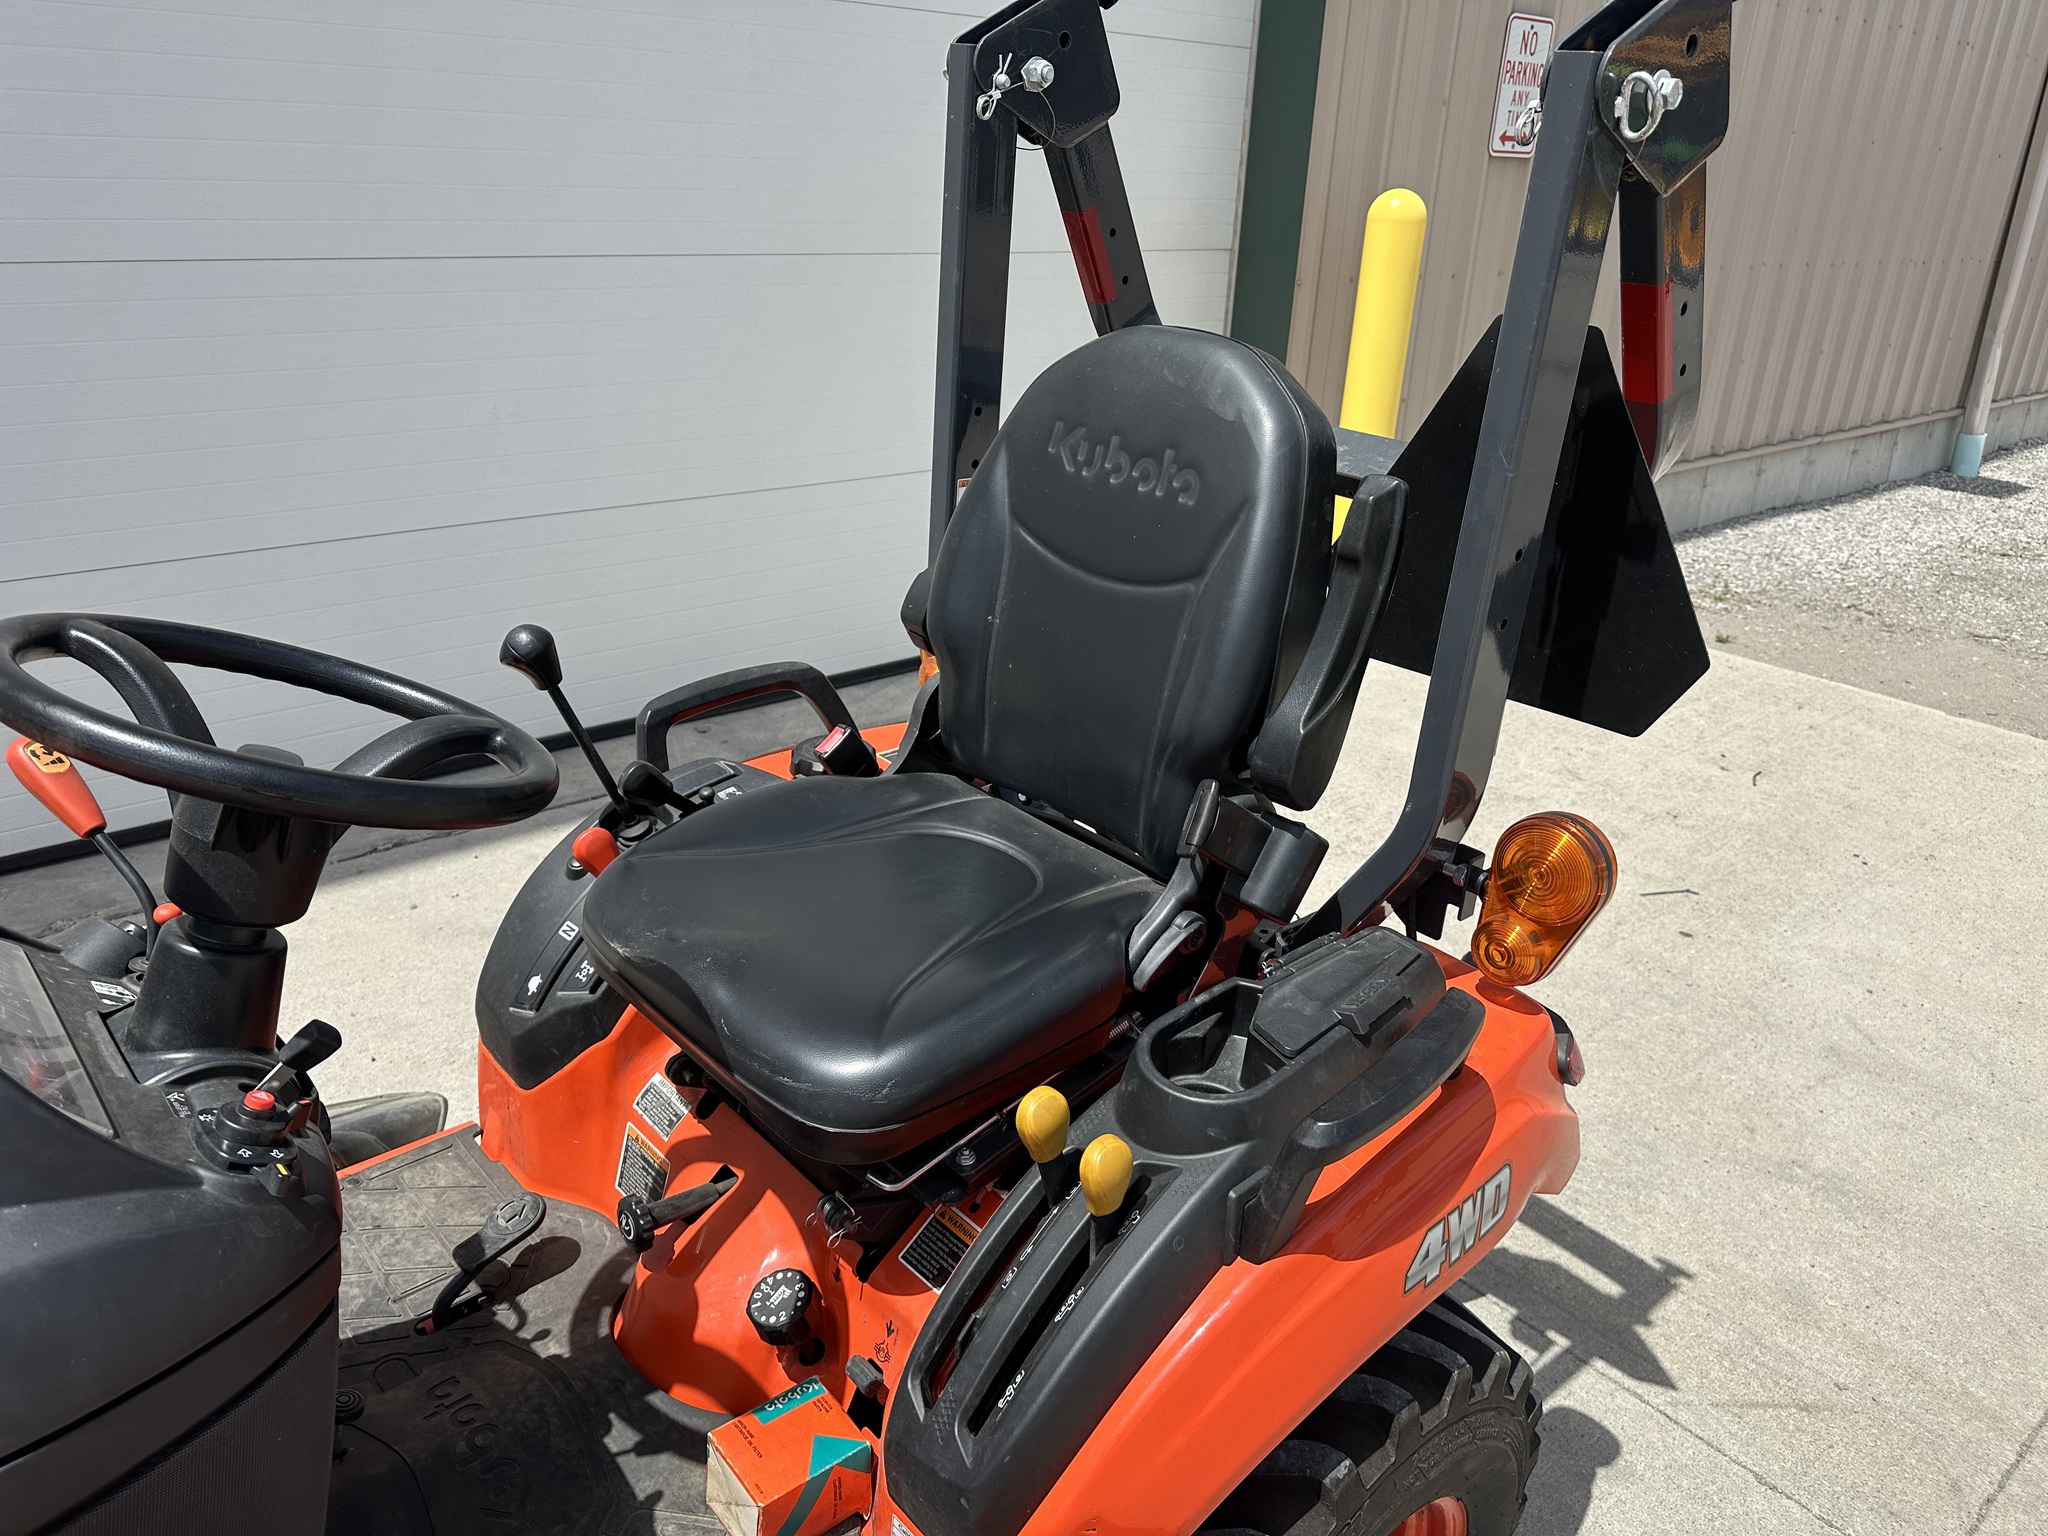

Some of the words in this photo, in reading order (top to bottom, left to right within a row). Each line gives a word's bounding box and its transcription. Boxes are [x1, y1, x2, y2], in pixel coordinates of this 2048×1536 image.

[1519, 29, 1539, 57] NO
[1510, 90, 1530, 107] ANY
[1047, 420, 1200, 506] Kubota
[560, 923, 577, 939] N
[657, 1079, 688, 1109] IMPORTANT
[639, 1139, 663, 1165] WARNING
[1403, 1163, 1512, 1294] 4WD
[766, 1276, 774, 1286] 4
[794, 1282, 805, 1291] 3
[778, 1310, 787, 1322] 2
[763, 1382, 821, 1411] Kubota
[423, 1373, 533, 1536] Kubota
